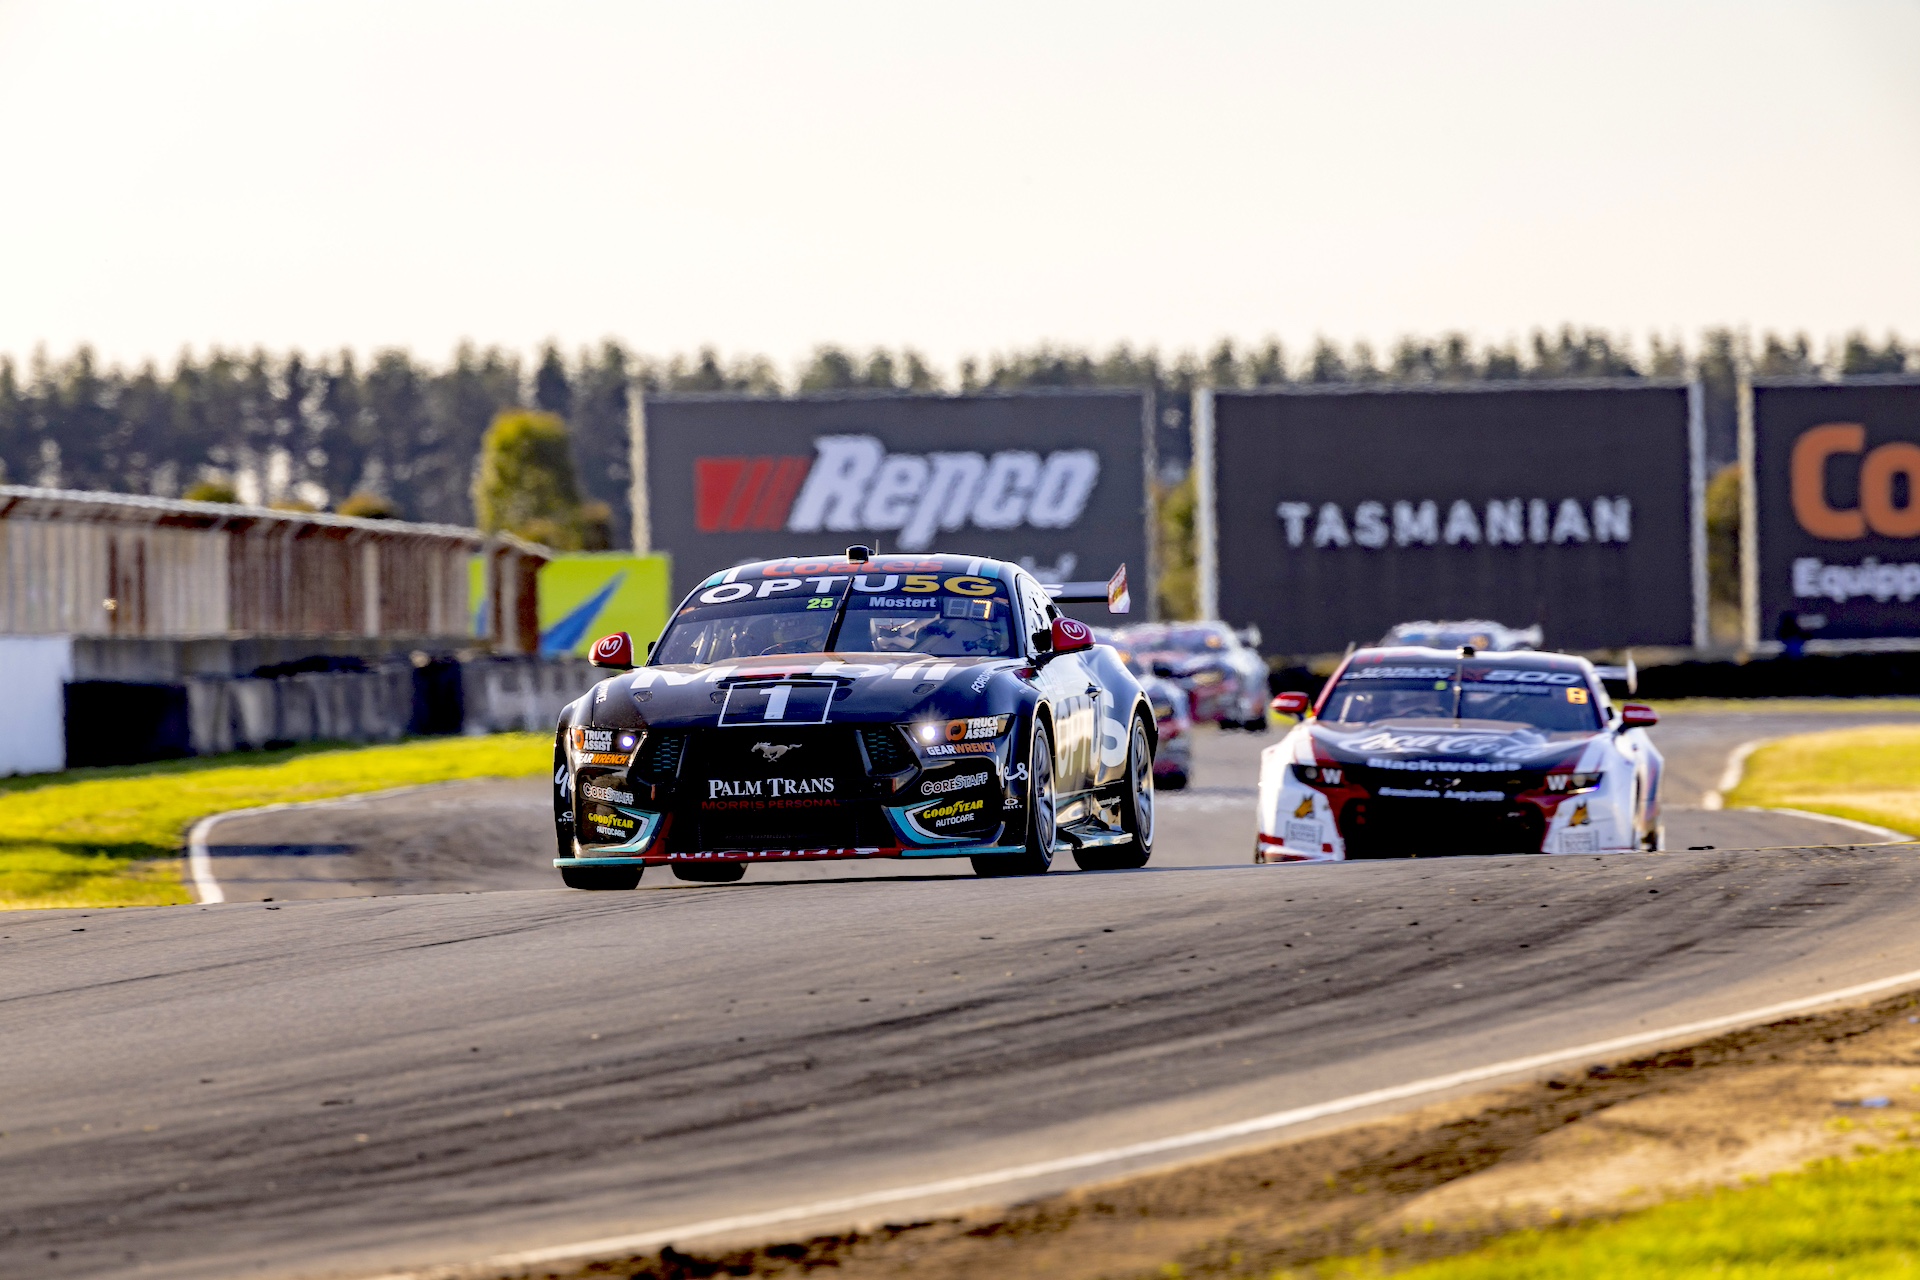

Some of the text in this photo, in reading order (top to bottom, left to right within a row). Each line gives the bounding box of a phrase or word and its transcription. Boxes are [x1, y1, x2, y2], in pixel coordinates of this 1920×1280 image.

[786, 434, 1101, 550] Repco
[1277, 496, 1632, 548] TASMANIAN
[762, 559, 944, 577] Coates
[806, 596, 937, 610] 25 Mostert
[759, 684, 793, 720] 1
[967, 715, 999, 729] TRUCK
[584, 729, 613, 742] TRUCK
[965, 726, 999, 740] ASSIST
[583, 740, 612, 752] ASSIST
[926, 742, 997, 756] GEARWRENCH
[575, 752, 629, 765] EARWRENCH
[1367, 757, 1522, 773] Blackwoods
[1321, 767, 1343, 785] W
[1546, 774, 1567, 791] W
[708, 777, 835, 799] PALM TRANS
[701, 798, 841, 811] MORRIS PERSONAL
[923, 800, 984, 819] GOODYEAR
[936, 812, 975, 828] AUTOCARE
